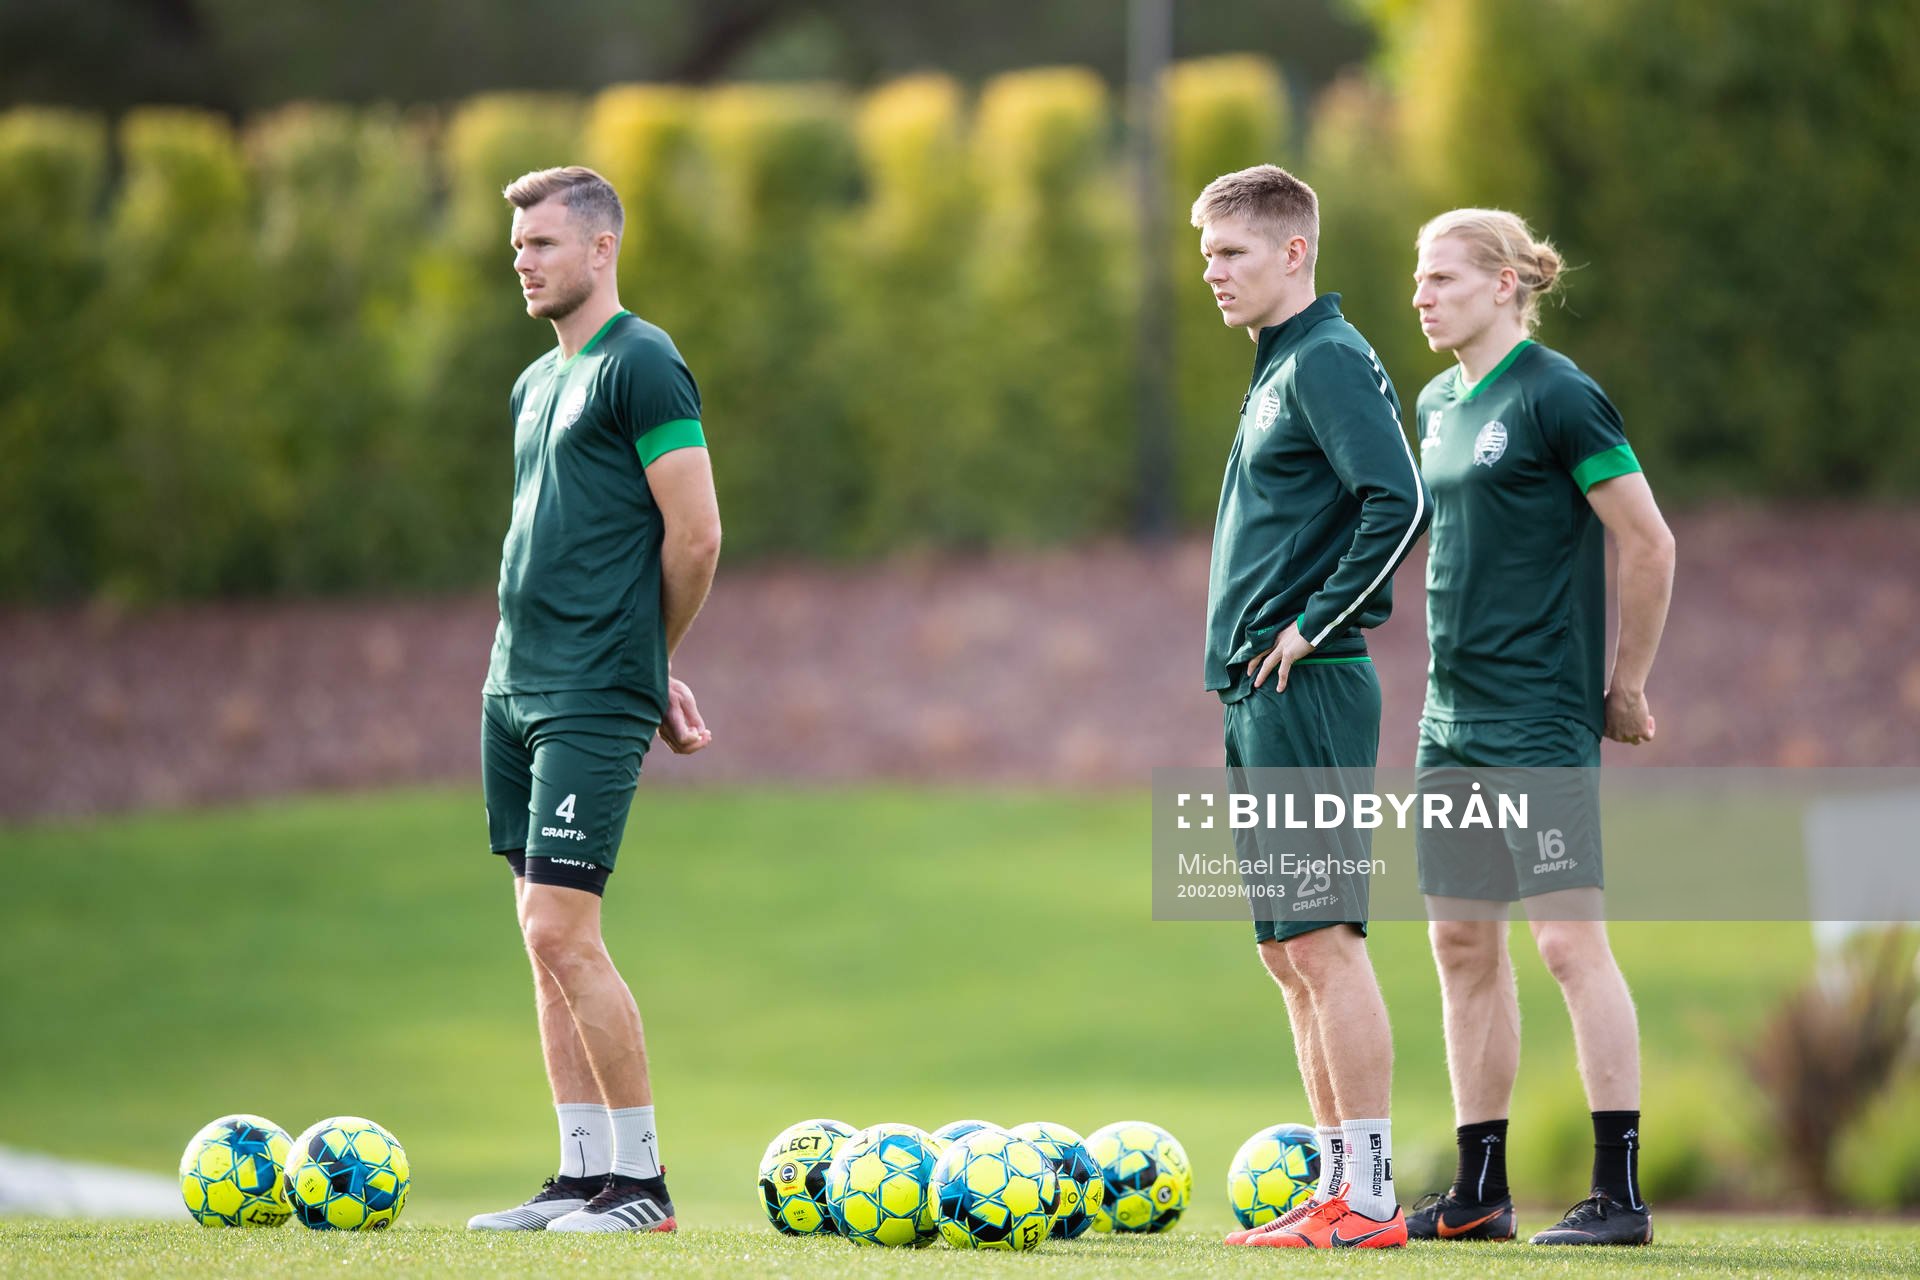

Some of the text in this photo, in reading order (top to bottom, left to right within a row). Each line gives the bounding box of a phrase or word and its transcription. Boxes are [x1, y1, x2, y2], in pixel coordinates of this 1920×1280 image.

[555, 793, 577, 824] 4
[541, 826, 577, 840] CRAFT
[1536, 828, 1566, 862] 16
[1533, 860, 1569, 875] CRAFT
[1292, 896, 1329, 911] CRAFT
[772, 1136, 822, 1159] LECT
[1371, 1149, 1383, 1197] TAPEDESIGN
